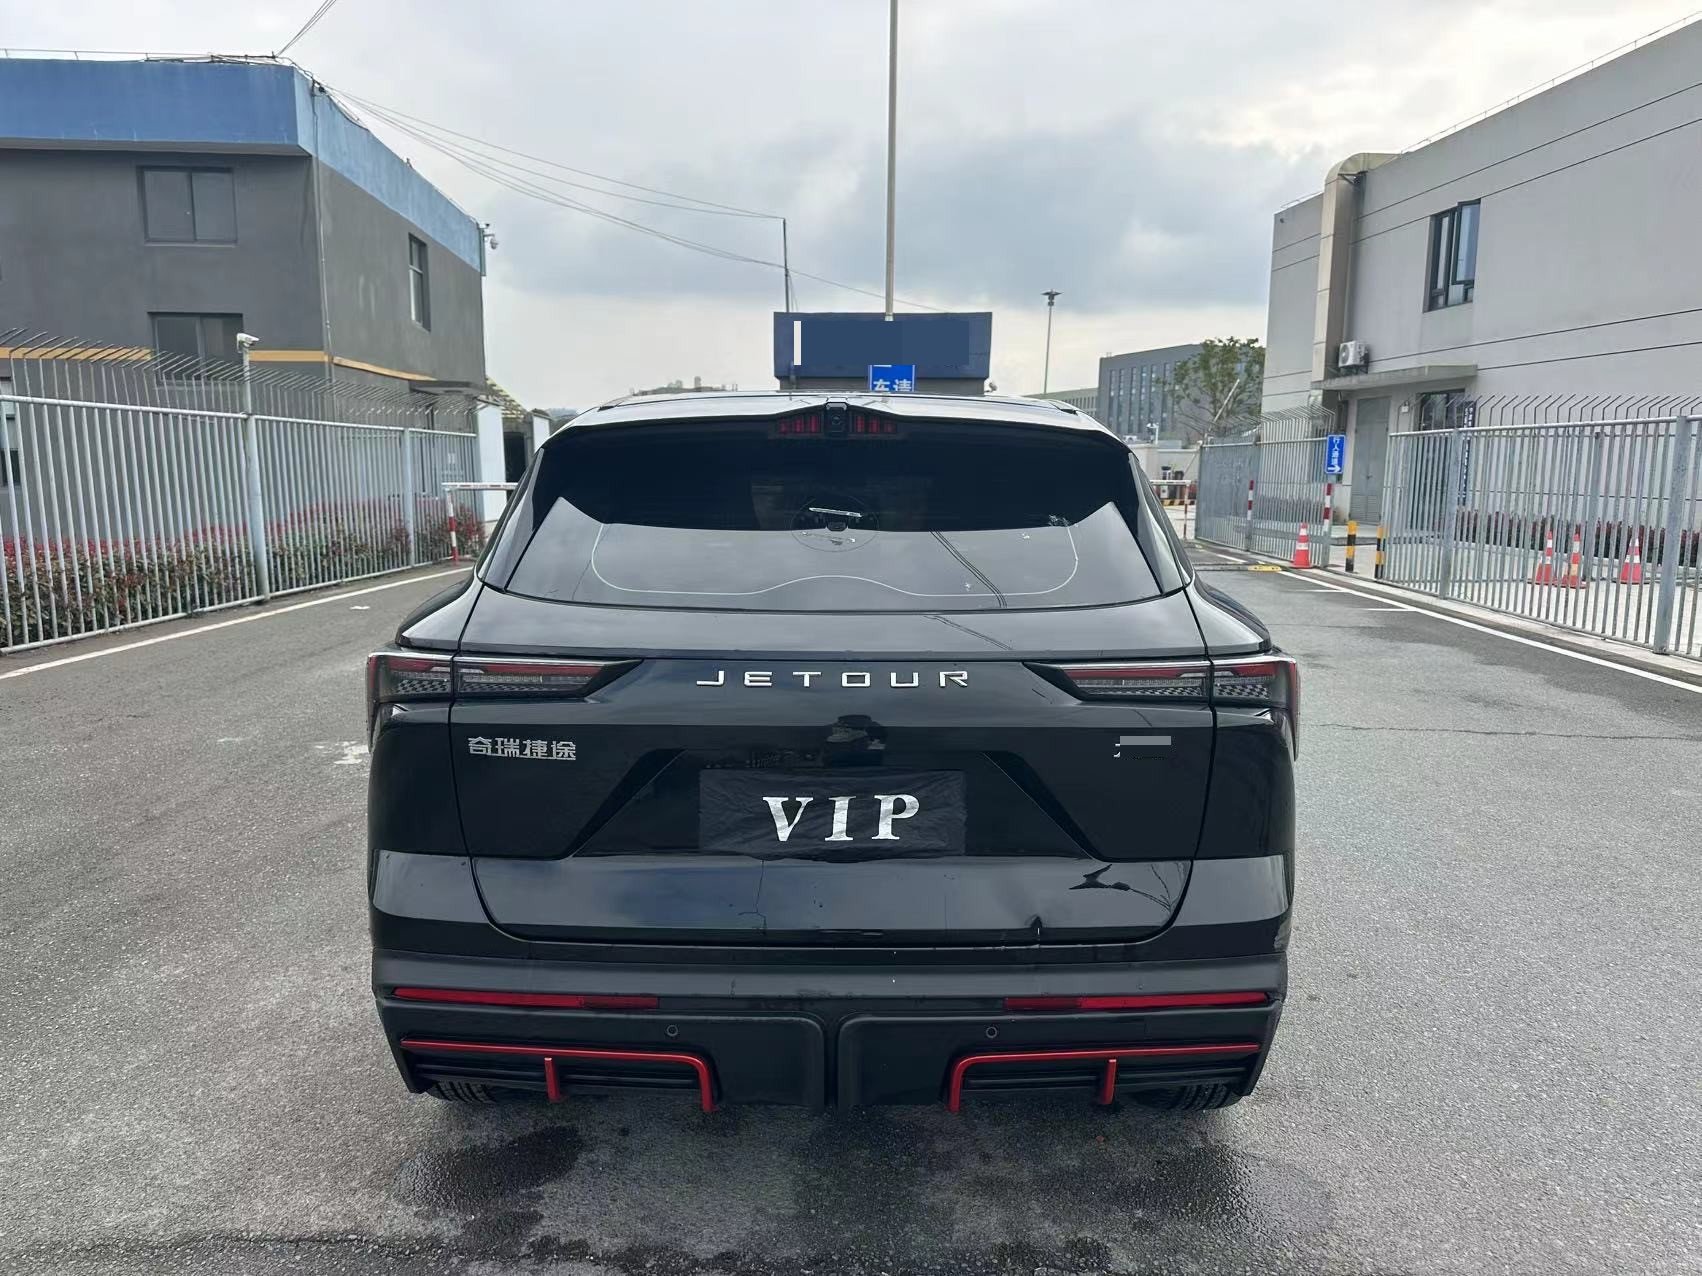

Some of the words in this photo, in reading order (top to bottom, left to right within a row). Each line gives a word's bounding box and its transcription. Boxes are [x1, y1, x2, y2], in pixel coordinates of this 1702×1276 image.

[696, 671, 968, 688] JETOUR
[468, 736, 577, 761] 奇瑞捷途
[762, 794, 920, 842] VIP
